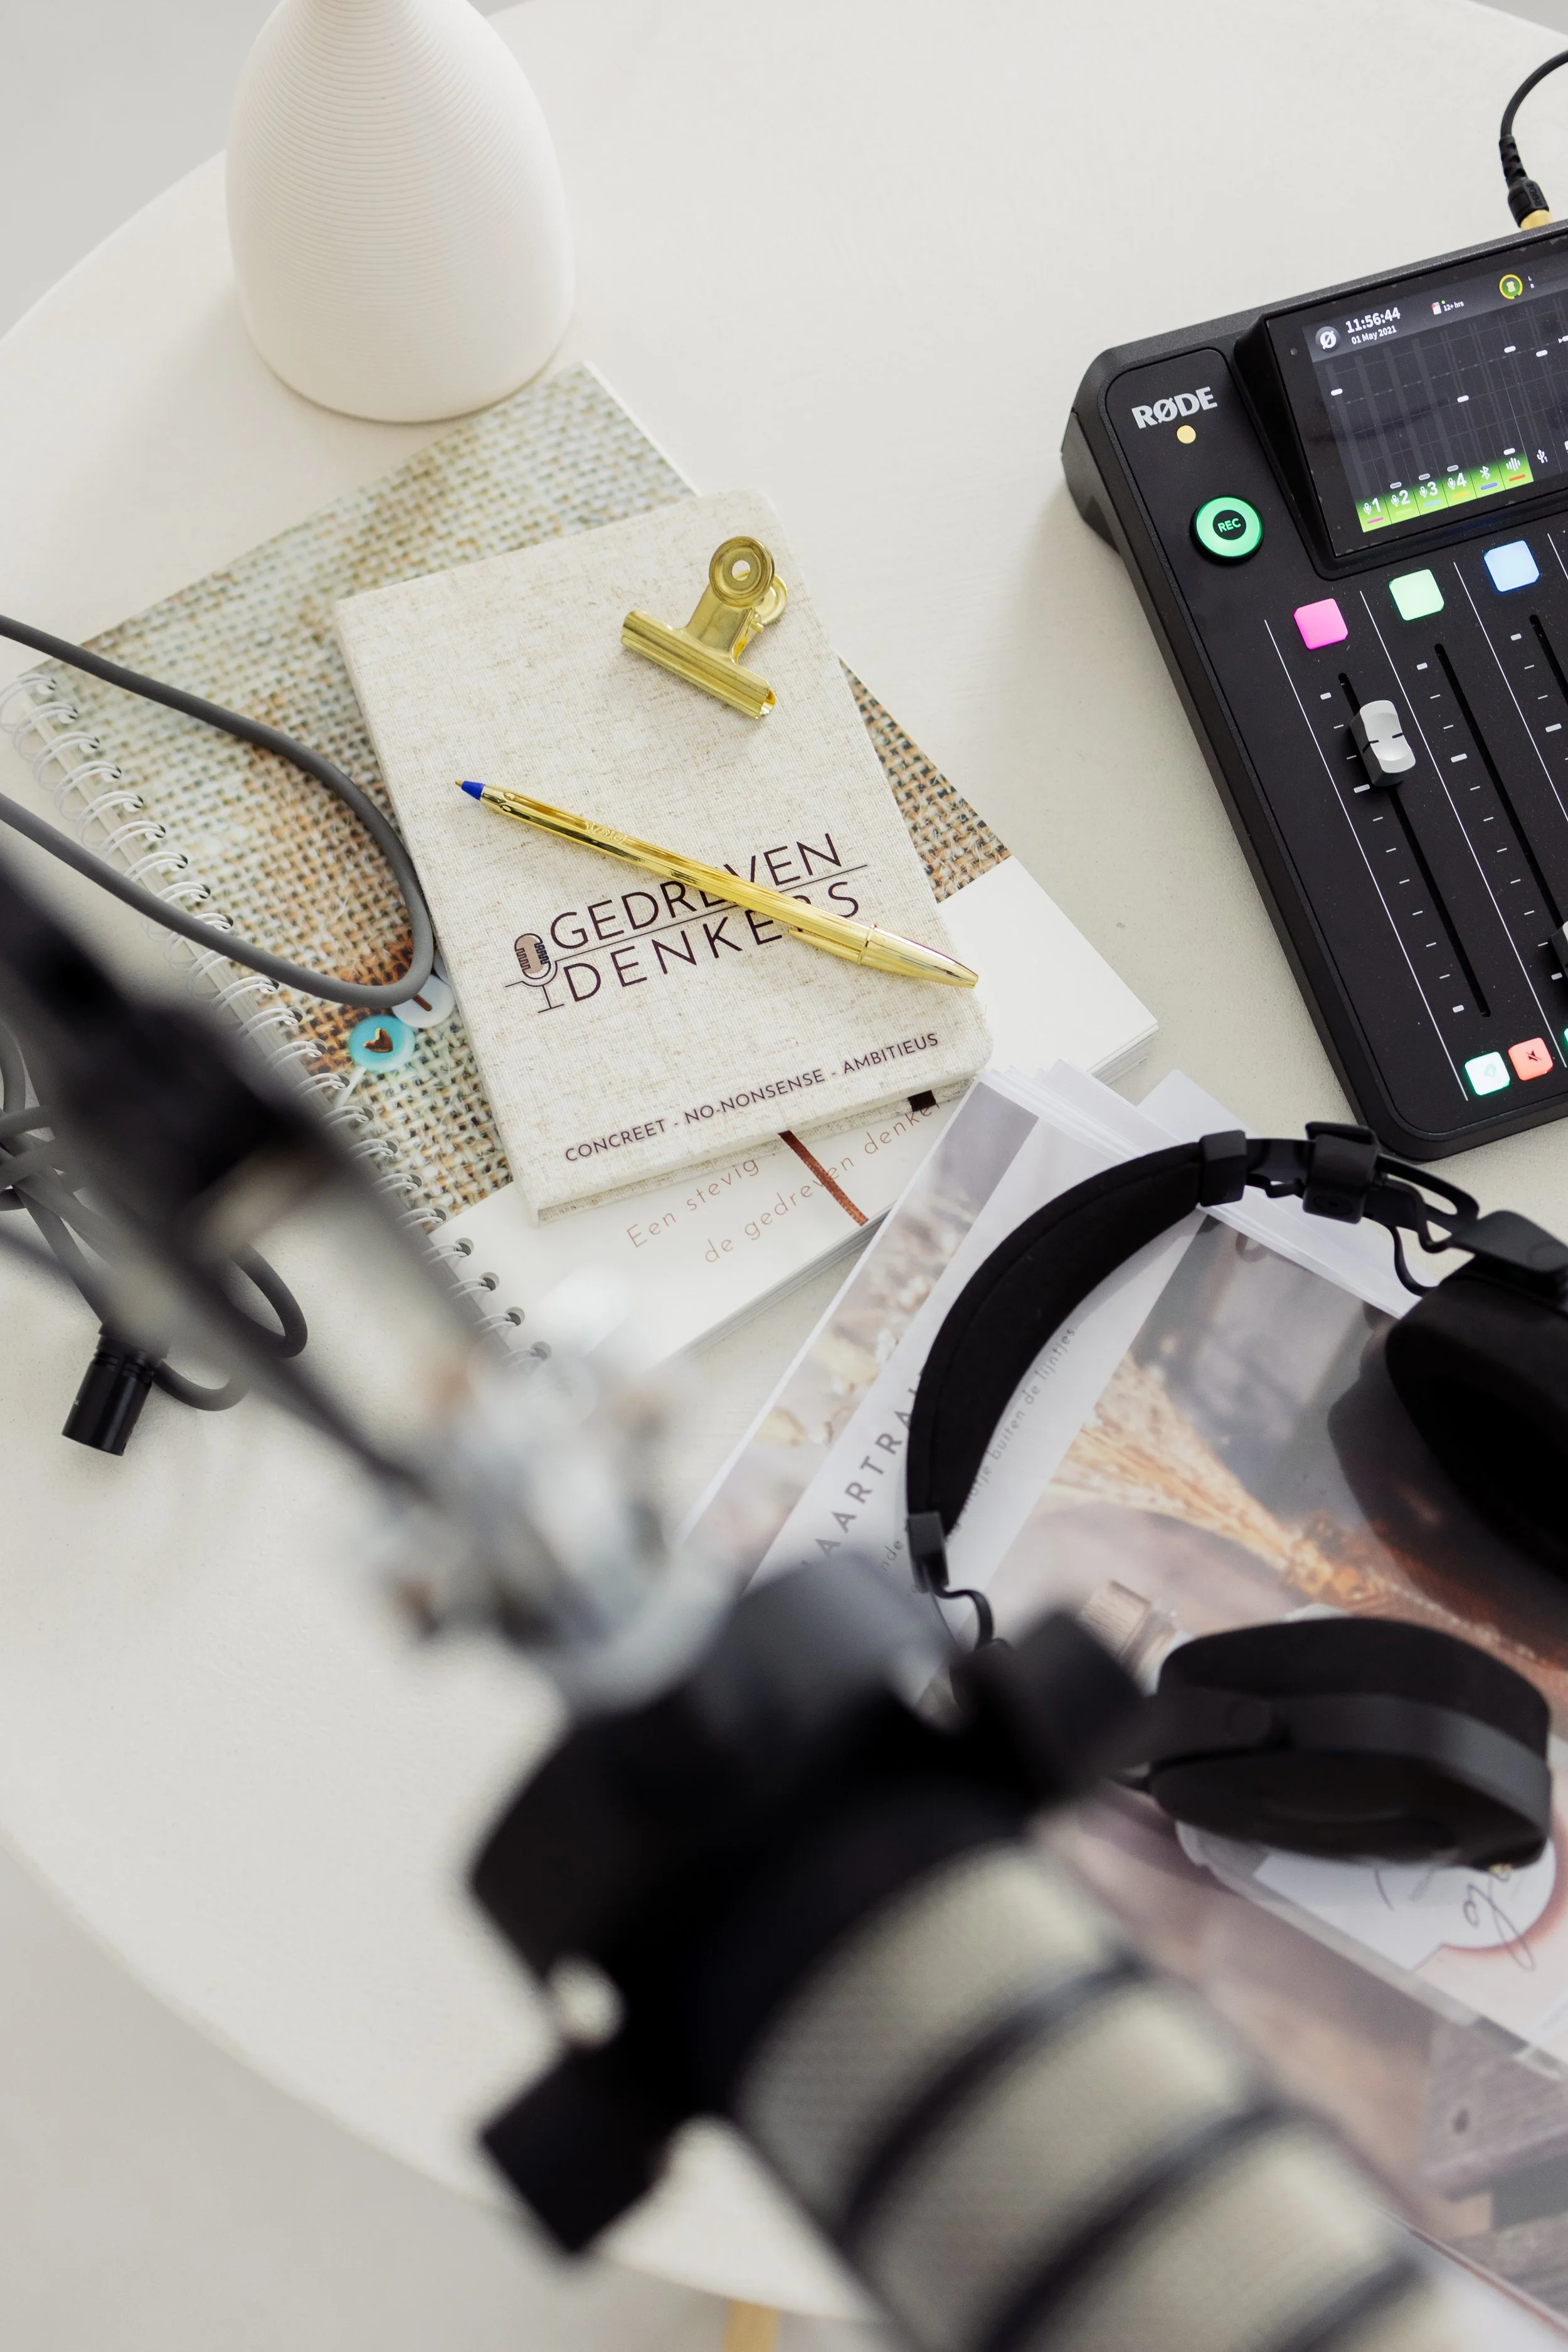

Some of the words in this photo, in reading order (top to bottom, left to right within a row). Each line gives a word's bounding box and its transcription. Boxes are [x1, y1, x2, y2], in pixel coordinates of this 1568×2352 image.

[1345, 307, 1401, 334] 11:56:44
[1443, 304, 1454, 312] 12+
[1351, 336, 1362, 345] 01
[1362, 331, 1377, 341] May
[1379, 325, 1397, 337] 2021
[1131, 386, 1218, 429] RØDE
[1372, 497, 1381, 512] 1
[1399, 489, 1411, 505] 2
[1427, 481, 1438, 496] 3
[1456, 472, 1467, 487] 4
[1217, 517, 1241, 533] REC
[565, 1118, 666, 1163] CONCREET
[684, 1068, 825, 1125] NO-NONSENSE
[843, 1032, 939, 1074] AMBITIEUS
[627, 1211, 677, 1248] Een
[686, 1158, 760, 1211] stevig
[704, 1236, 734, 1263] de
[986, 1410, 1025, 1461] buiten
[1022, 1384, 1041, 1406] de
